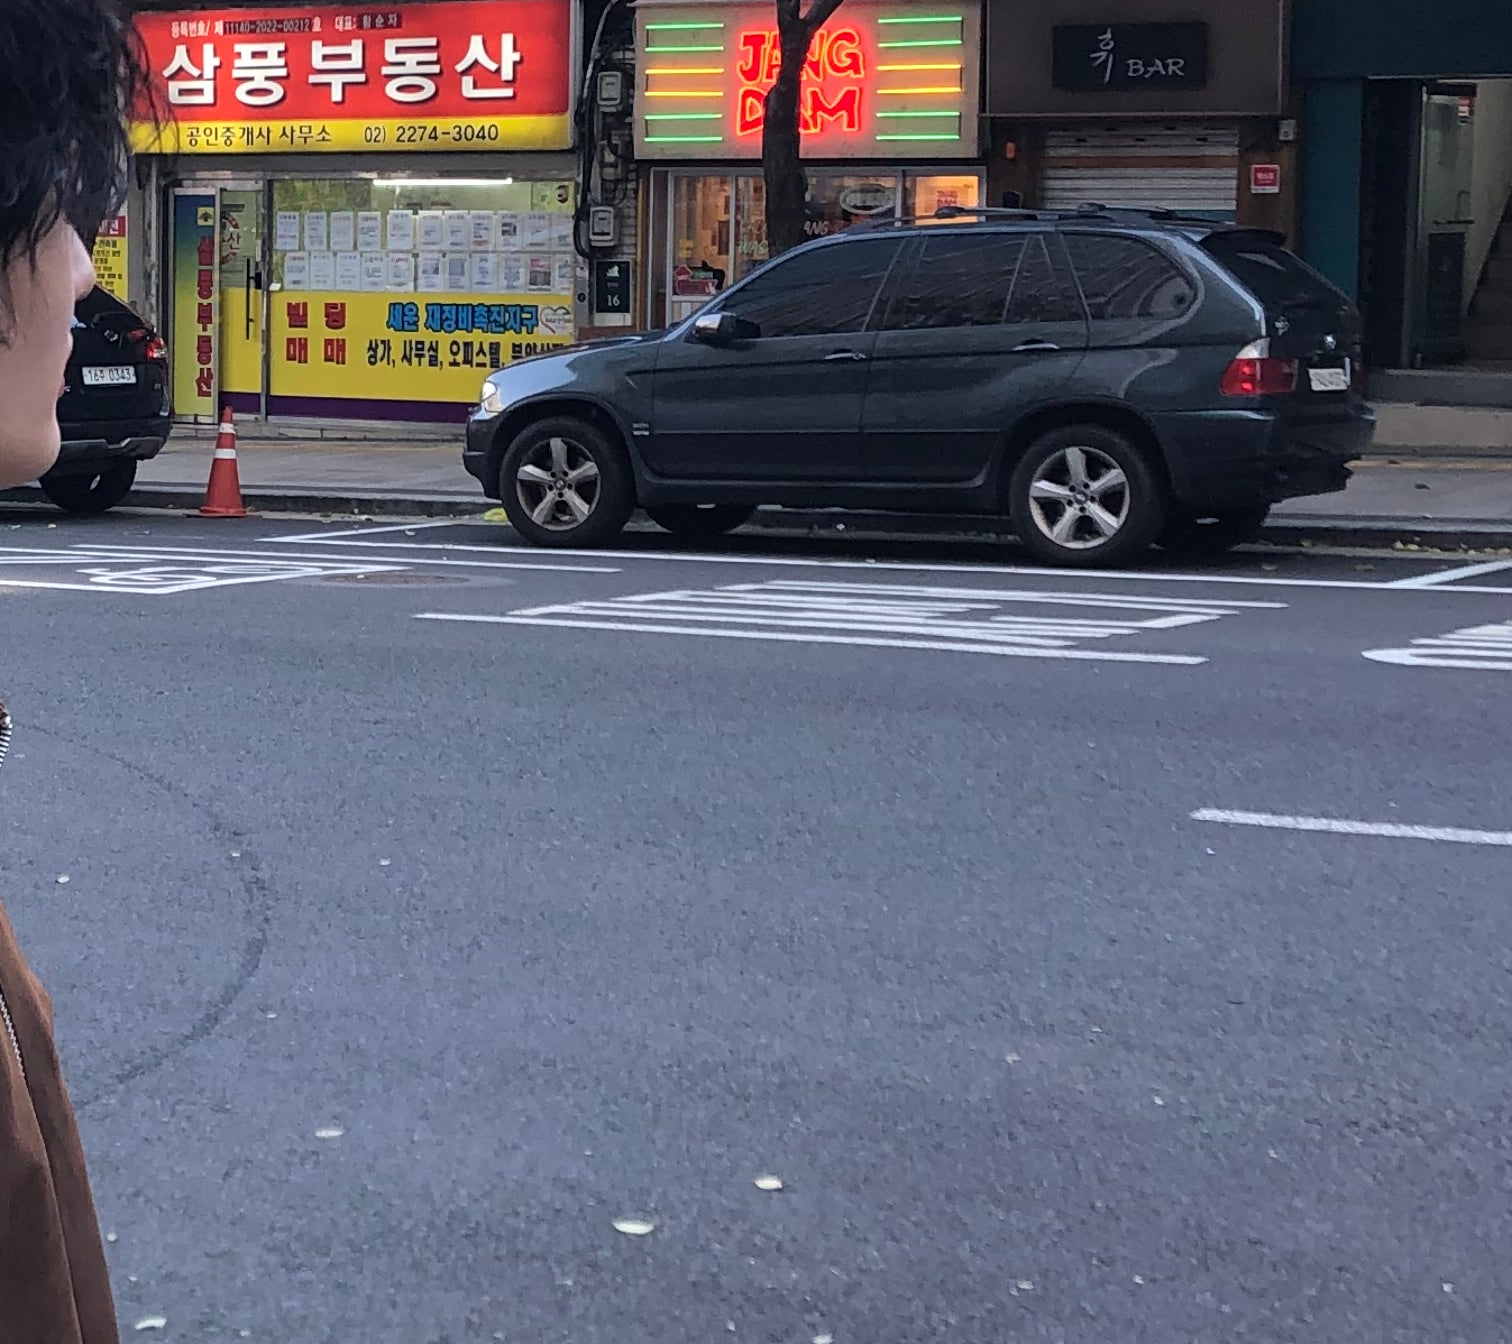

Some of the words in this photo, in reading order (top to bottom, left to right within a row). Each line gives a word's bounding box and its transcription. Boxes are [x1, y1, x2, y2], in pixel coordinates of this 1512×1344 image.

[1126, 58, 1185, 78] BAR
[736, 86, 863, 137] DM
[186, 127, 272, 148] 공인중개사
[279, 125, 332, 145] 사무소
[364, 125, 387, 144] 02)
[396, 123, 499, 143] 2274-3040
[607, 294, 621, 306] 16
[386, 302, 419, 332] 세운
[425, 303, 539, 335] 재정비촉진지구
